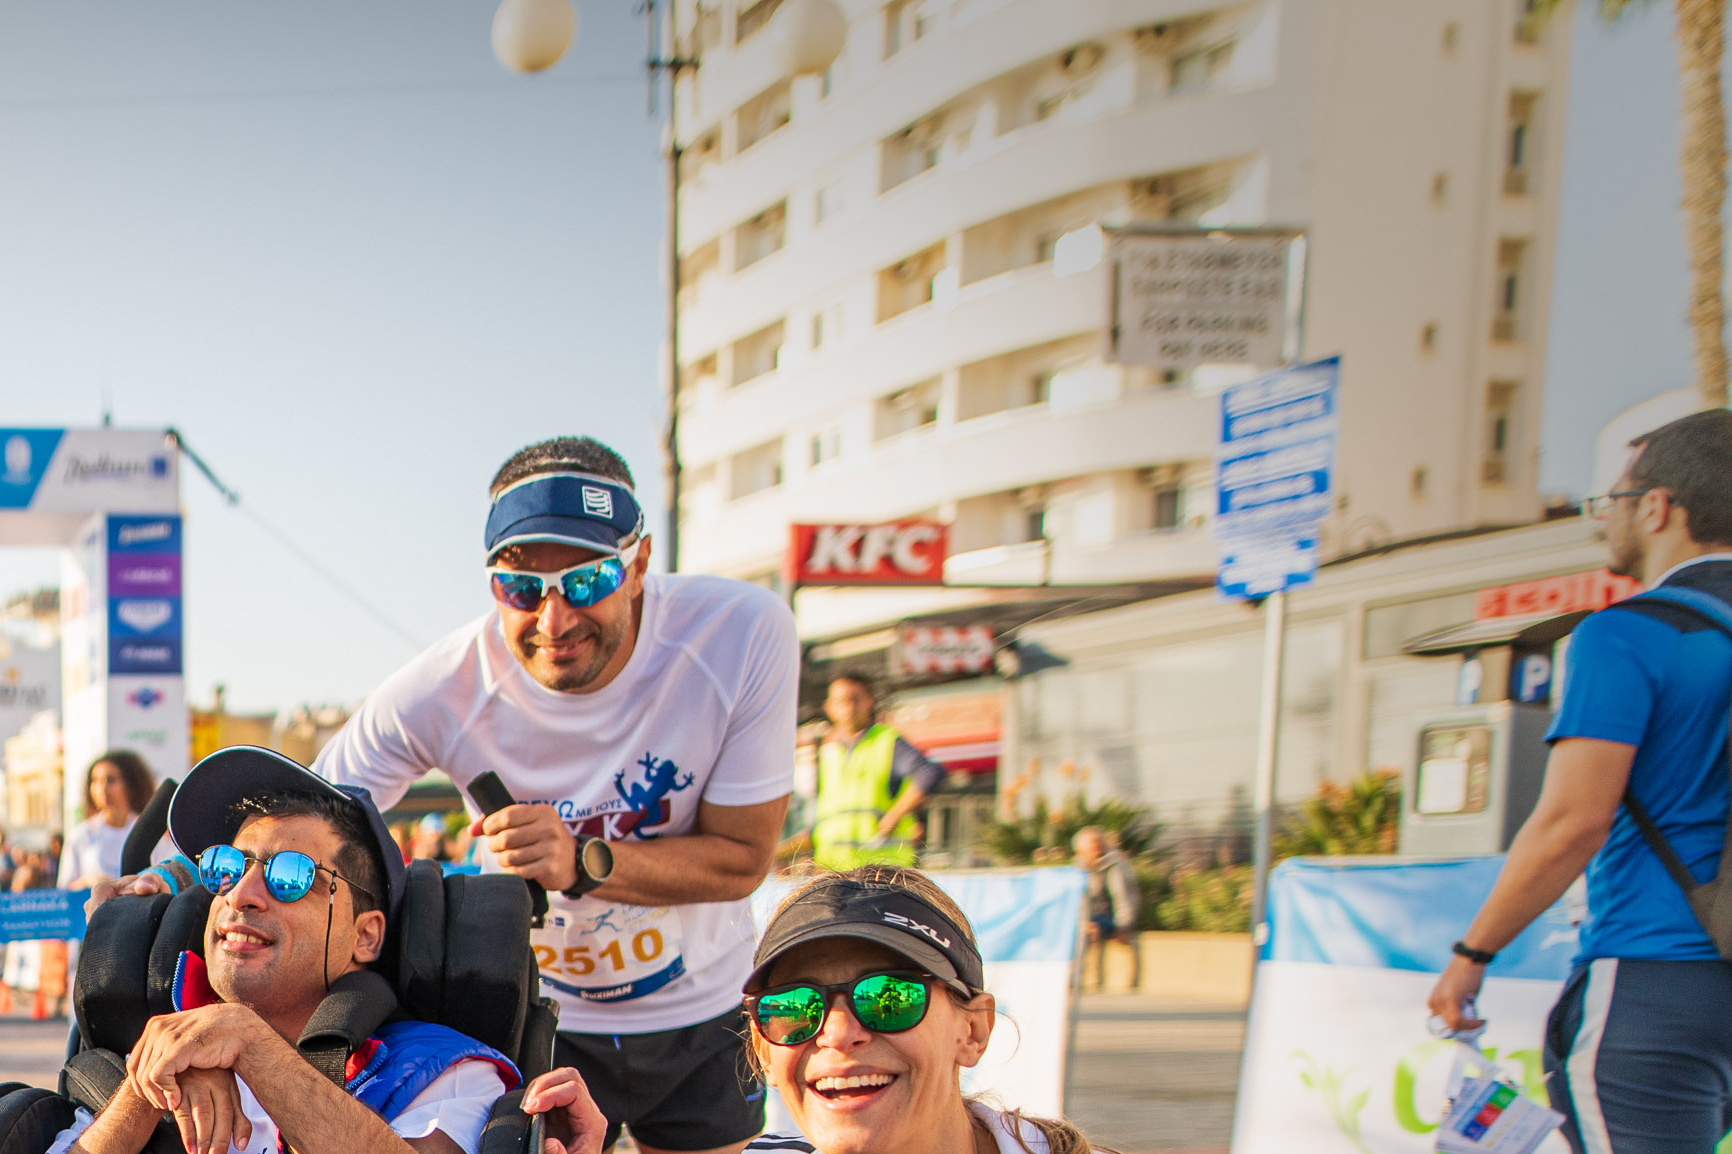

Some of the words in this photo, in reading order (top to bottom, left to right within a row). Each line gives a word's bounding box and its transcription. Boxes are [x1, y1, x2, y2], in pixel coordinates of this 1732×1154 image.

[805, 525, 938, 574] KFC
[1520, 655, 1550, 702] P
[532, 927, 664, 977] 2510
[882, 911, 951, 949] 2XU
